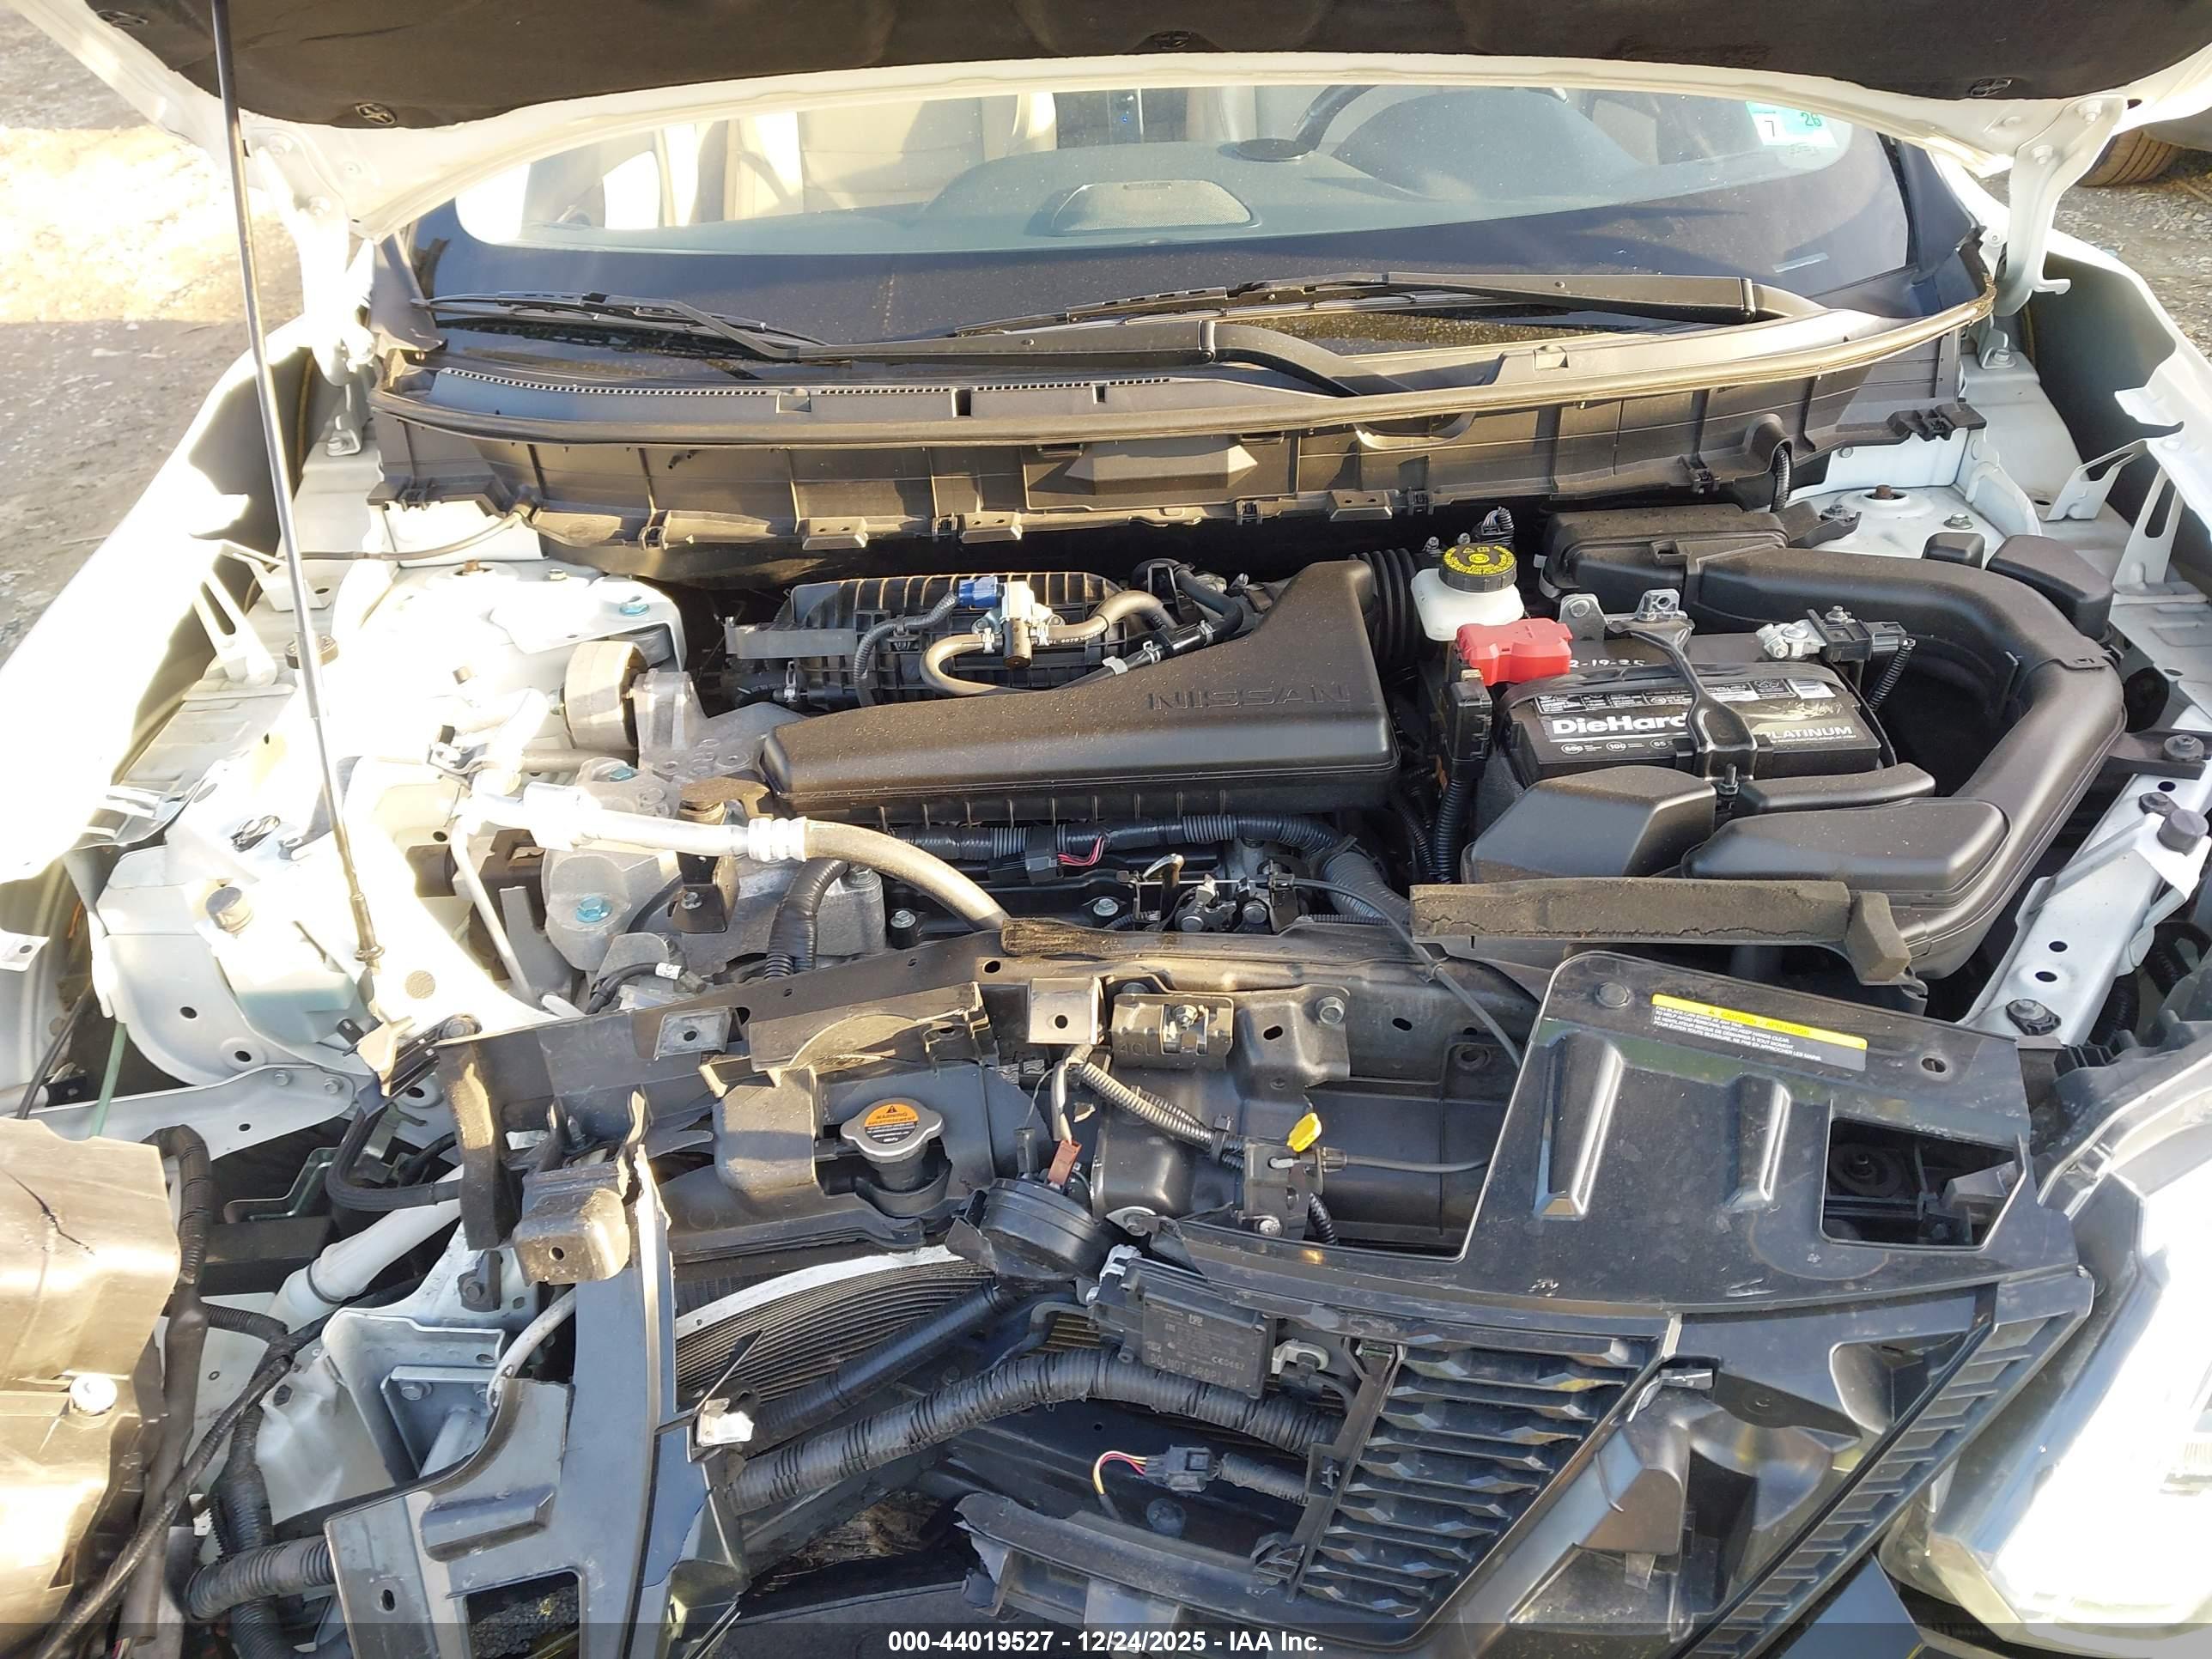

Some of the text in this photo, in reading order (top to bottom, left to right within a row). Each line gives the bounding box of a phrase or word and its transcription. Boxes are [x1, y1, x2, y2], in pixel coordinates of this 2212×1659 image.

[1800, 111, 1822, 126] 26
[1147, 687, 1352, 710] NISSAN
[1552, 711, 1688, 735] DieHard
[1167, 1358, 1188, 1371] NOT
